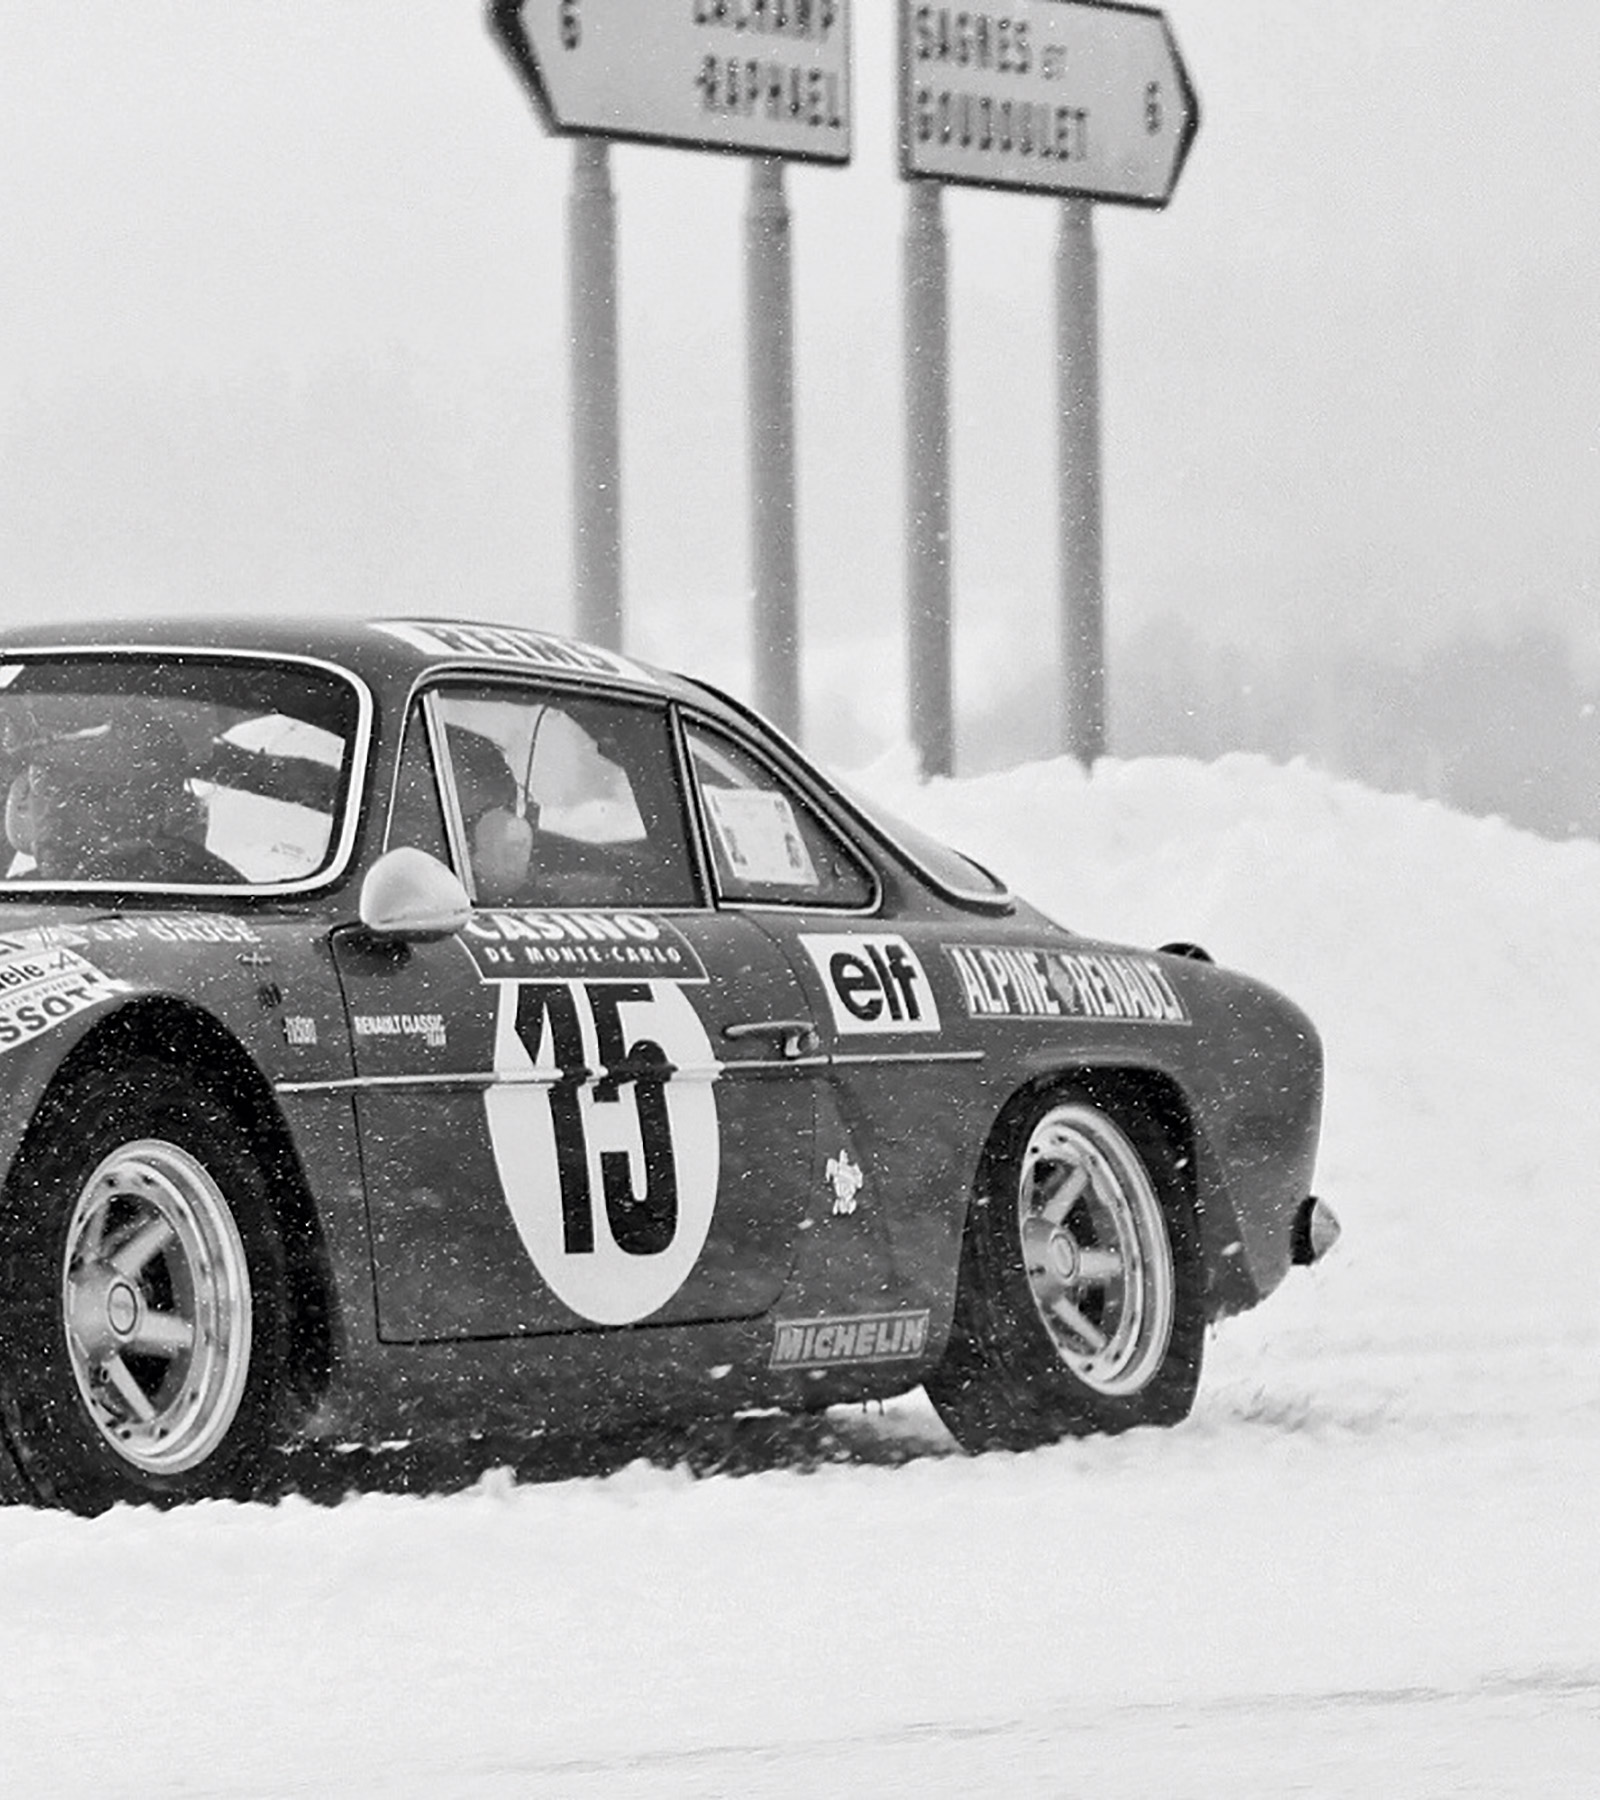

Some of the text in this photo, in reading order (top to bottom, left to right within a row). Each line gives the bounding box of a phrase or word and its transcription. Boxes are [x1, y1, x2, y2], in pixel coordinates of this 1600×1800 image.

[915, 7, 1030, 74] SAGNES
[1144, 80, 1163, 136] 6
[465, 913, 661, 941] CASINO
[485, 945, 516, 964] DE
[829, 943, 923, 1022] elf
[951, 947, 1184, 1021] ALPINE RENAULT
[514, 982, 679, 1256] 15
[775, 1317, 926, 1361] MICHELIN
